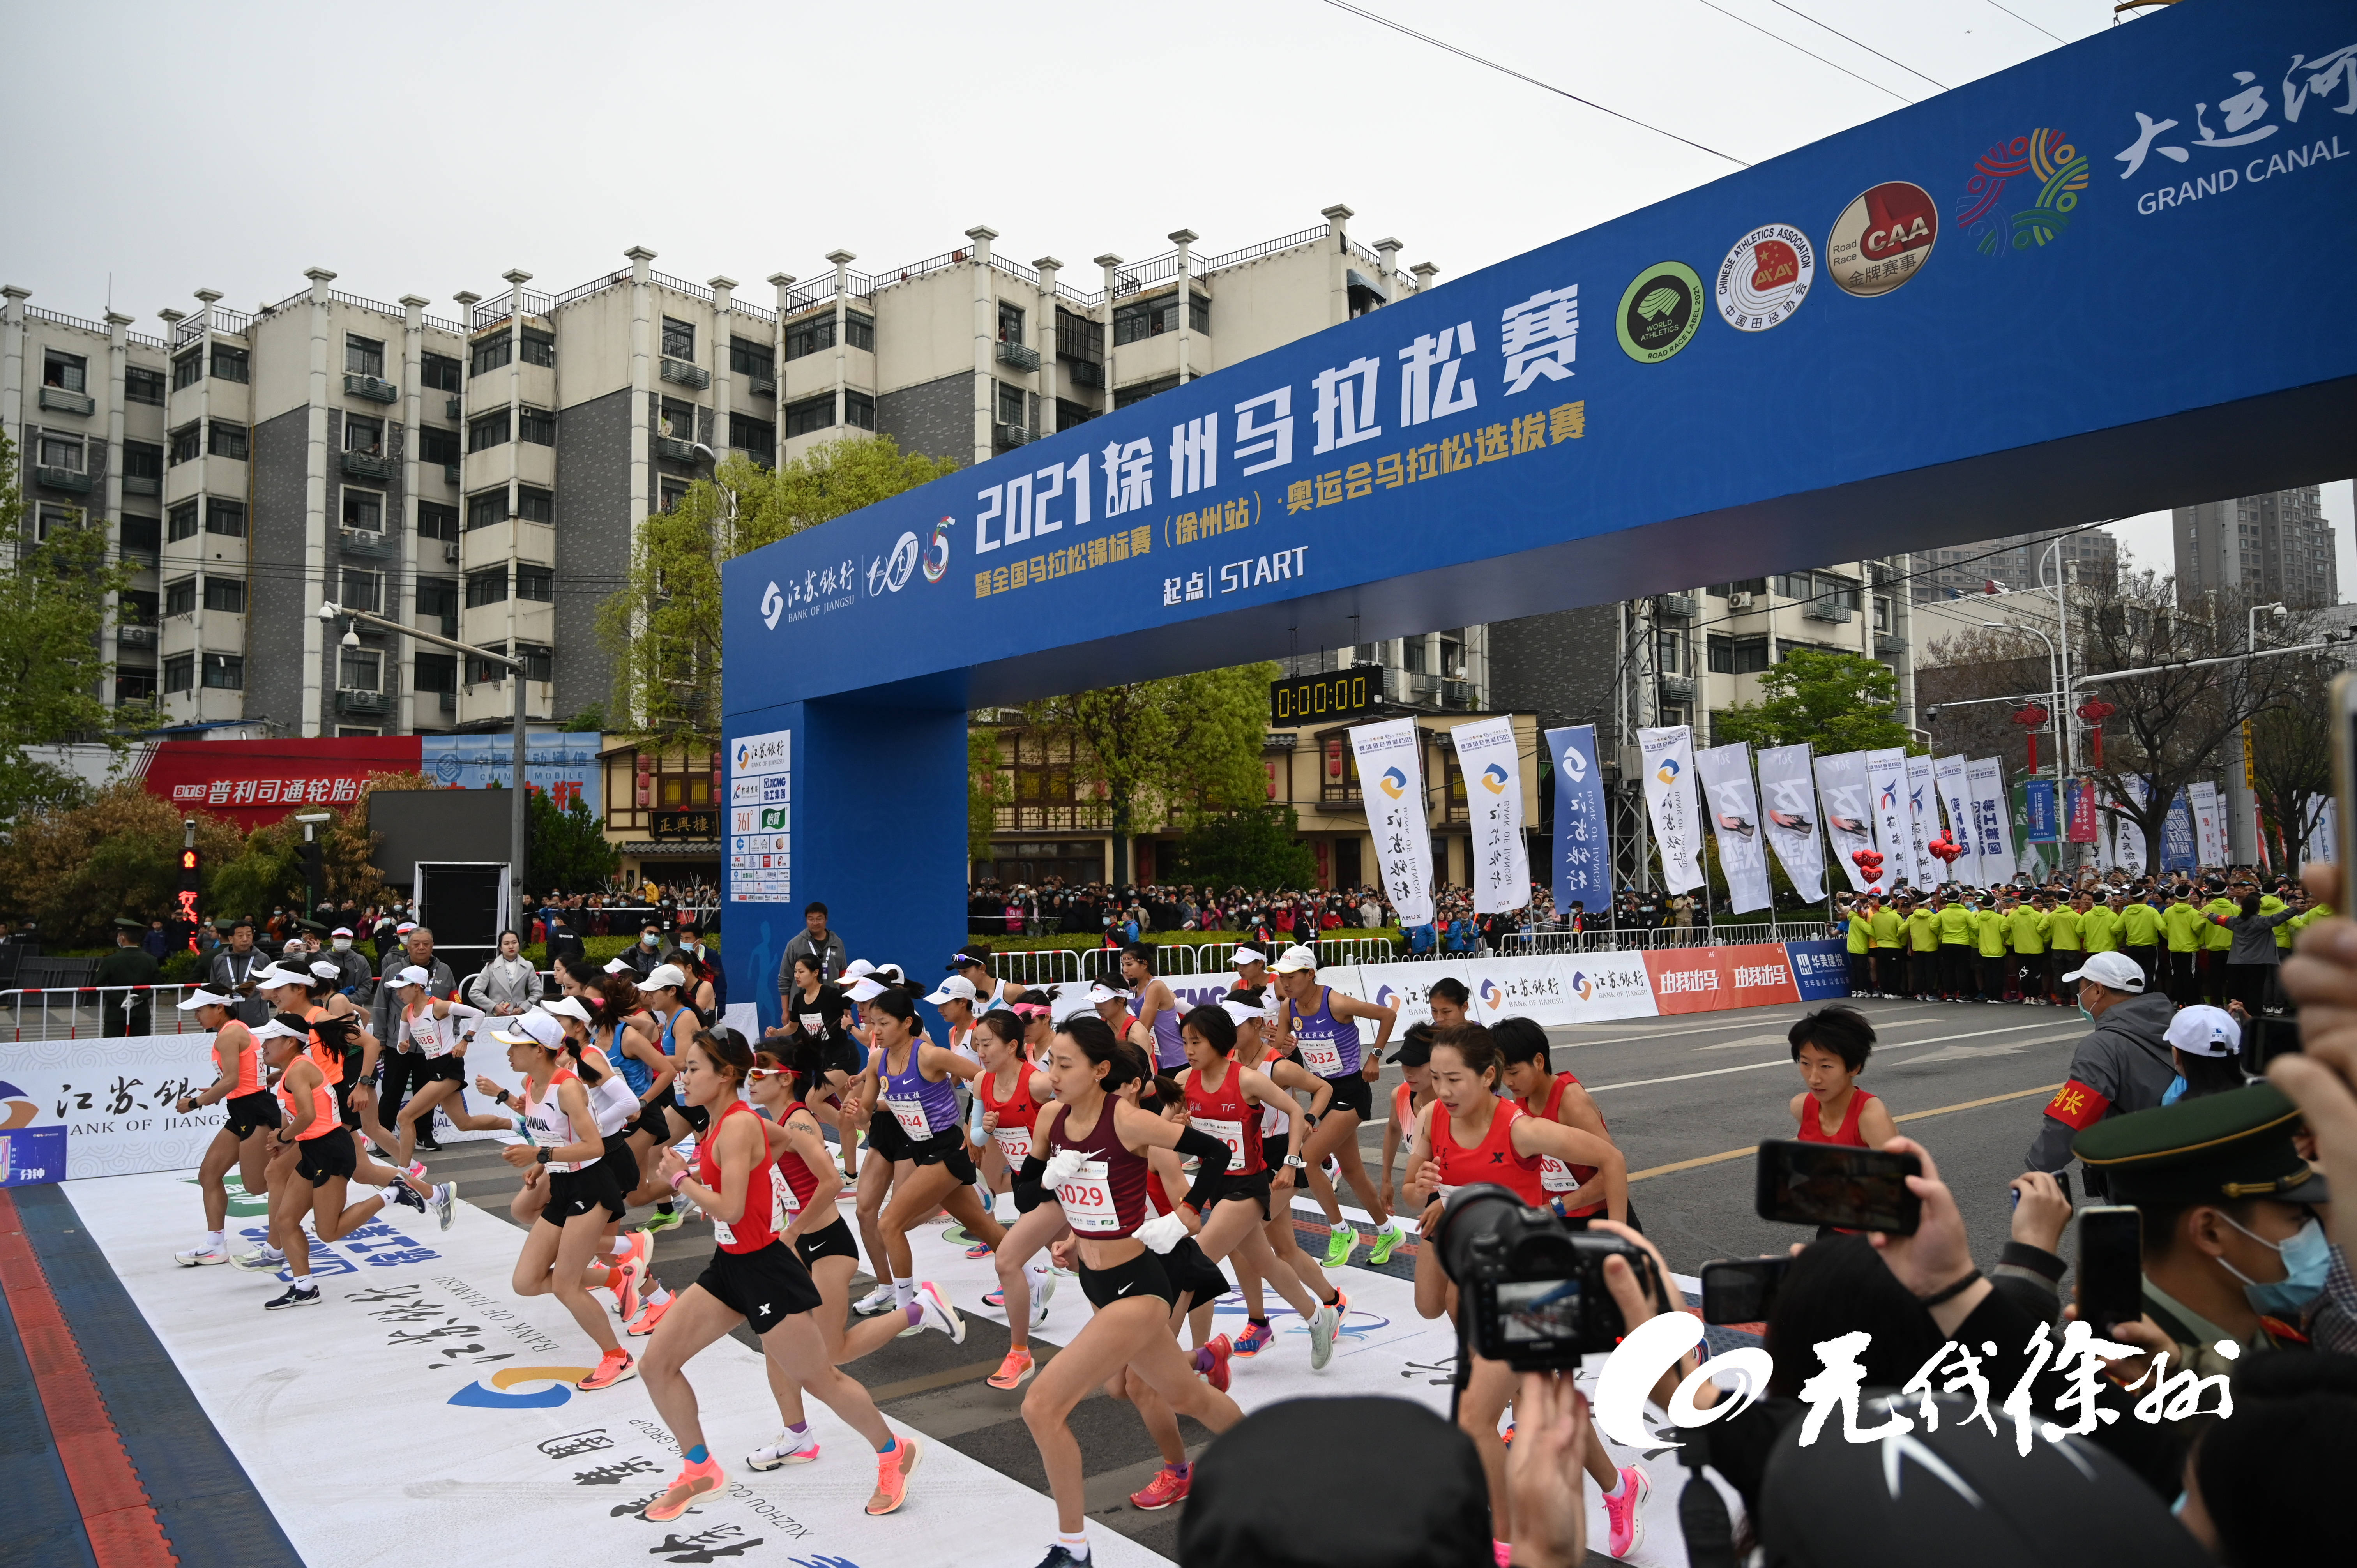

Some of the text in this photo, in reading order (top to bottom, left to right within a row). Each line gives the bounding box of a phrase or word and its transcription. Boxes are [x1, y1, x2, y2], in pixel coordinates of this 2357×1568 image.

[2114, 43, 2357, 179] 大运河
[2137, 135, 2350, 215] GRAND CANAL
[1867, 216, 1930, 252] CAA
[1833, 239, 1857, 254] Road
[1719, 227, 1811, 295] CHINESE ATHLETICS ASSOCIATION
[1833, 252, 1857, 267] Race
[1848, 253, 1917, 290] 金牌赛事
[1723, 283, 1808, 329] 中国田径协会
[1640, 323, 1679, 342] ATHLETICS
[1646, 318, 1673, 333] WORLD
[1647, 285, 1701, 360] ROAD RACE LABEL 2021
[788, 559, 855, 609] 江苏银行
[1163, 546, 1309, 606] 起点 START
[788, 594, 855, 623] BANK OF JIANGSU
[1278, 676, 1365, 718] 0:00:00
[751, 740, 784, 760] 江苏银行
[769, 758, 784, 767] JIANGSU
[480, 772, 583, 781] CHIN MOBILE
[769, 777, 786, 788] XCMG
[173, 785, 207, 798] BTS
[764, 789, 786, 801] 徐工集团
[1863, 855, 1879, 864] 2:00
[1811, 953, 1845, 969] 华美建投
[1504, 977, 1559, 998] 江苏银行
[1594, 969, 1645, 990] 江苏银行
[1804, 979, 1827, 987] 百年基业
[1509, 1000, 1527, 1008] BANK
[1539, 997, 1564, 1006] JIANGSU
[1626, 989, 1648, 998] JIANGSU
[2049, 1086, 2085, 1116] 判长
[70, 1114, 230, 1135] ANK OF JIANGS
[897, 1114, 922, 1127] 034
[20, 1167, 45, 1180] 分钟
[431, 1276, 561, 1353] BANK OF JIANGSU
[744, 1499, 815, 1540] XUZHOU
